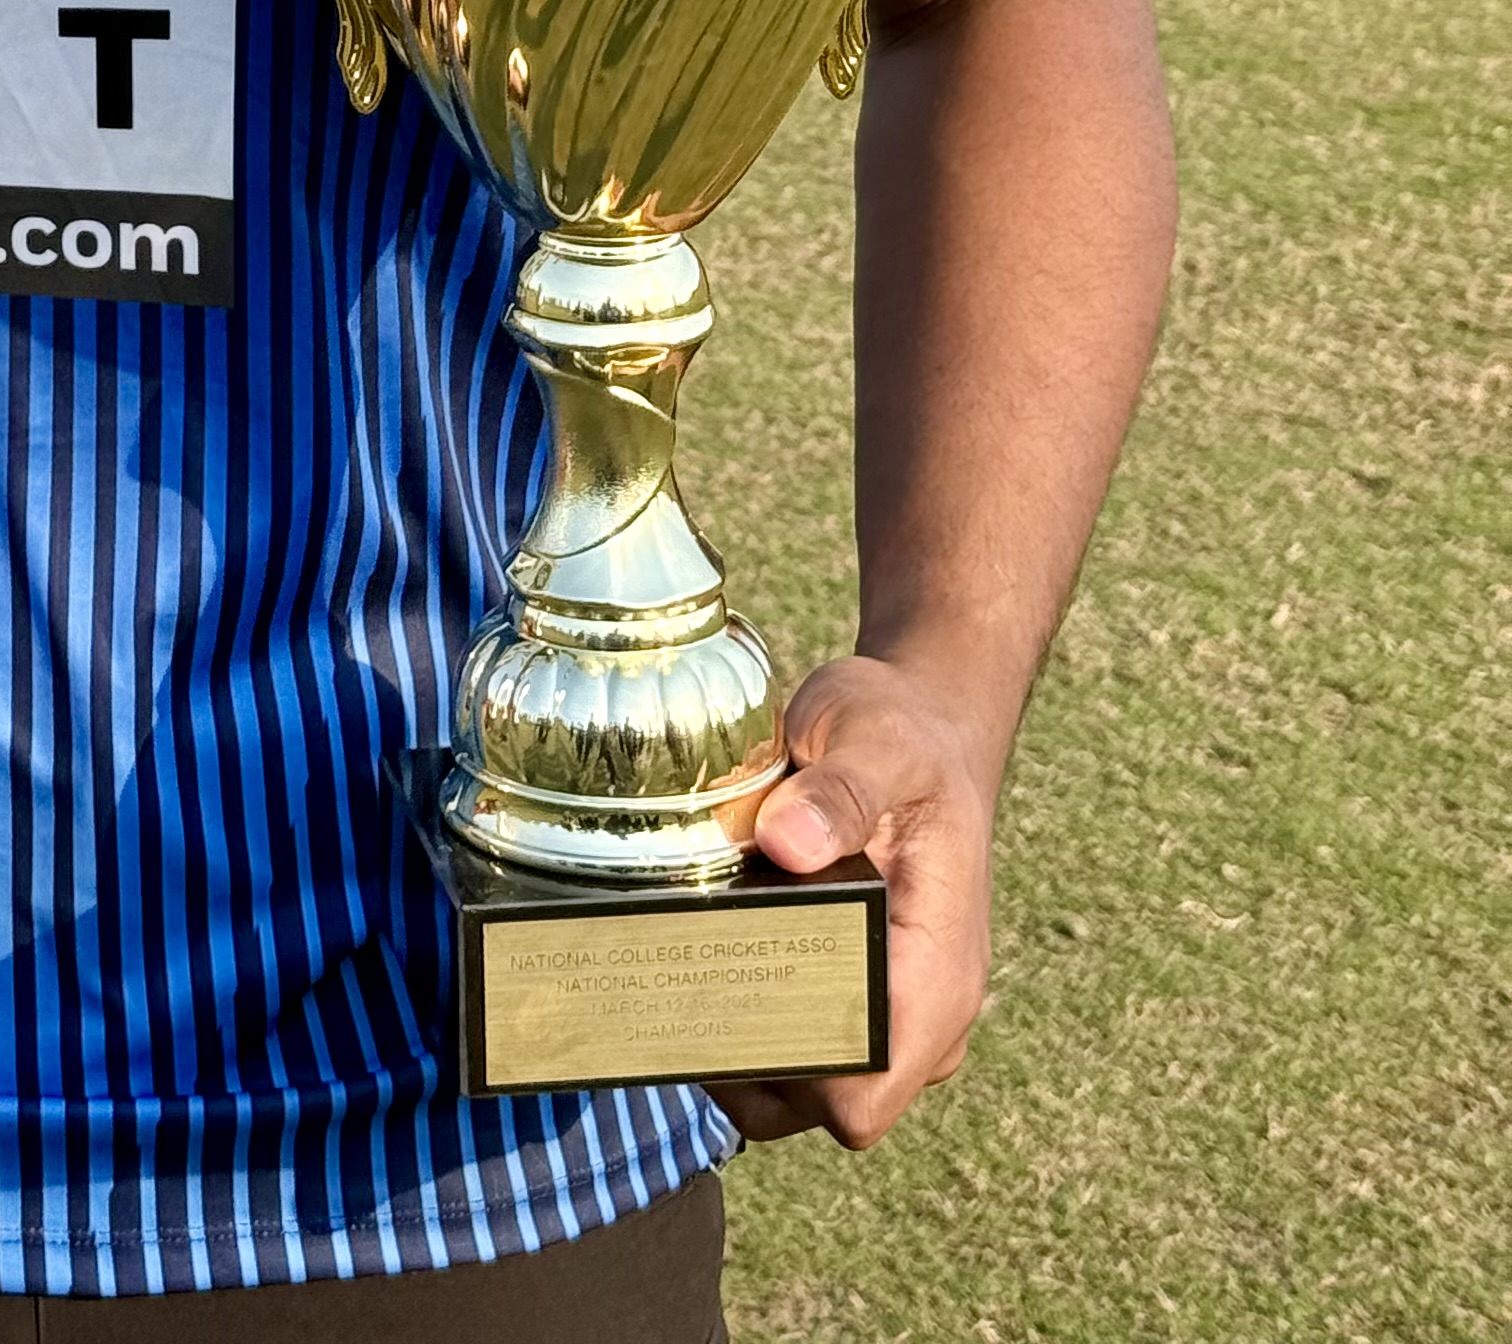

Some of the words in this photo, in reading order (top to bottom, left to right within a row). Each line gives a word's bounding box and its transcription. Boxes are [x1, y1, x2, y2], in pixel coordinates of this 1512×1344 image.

[509, 951, 603, 972] NATIONAL
[606, 944, 694, 966] COLLEGE
[699, 939, 780, 960] CRICKET
[785, 936, 837, 955] ASSO
[556, 974, 649, 994] NATIONAL
[653, 964, 796, 989] CHAMPIONSHIP
[622, 1020, 733, 1042] CHAMPIONS
